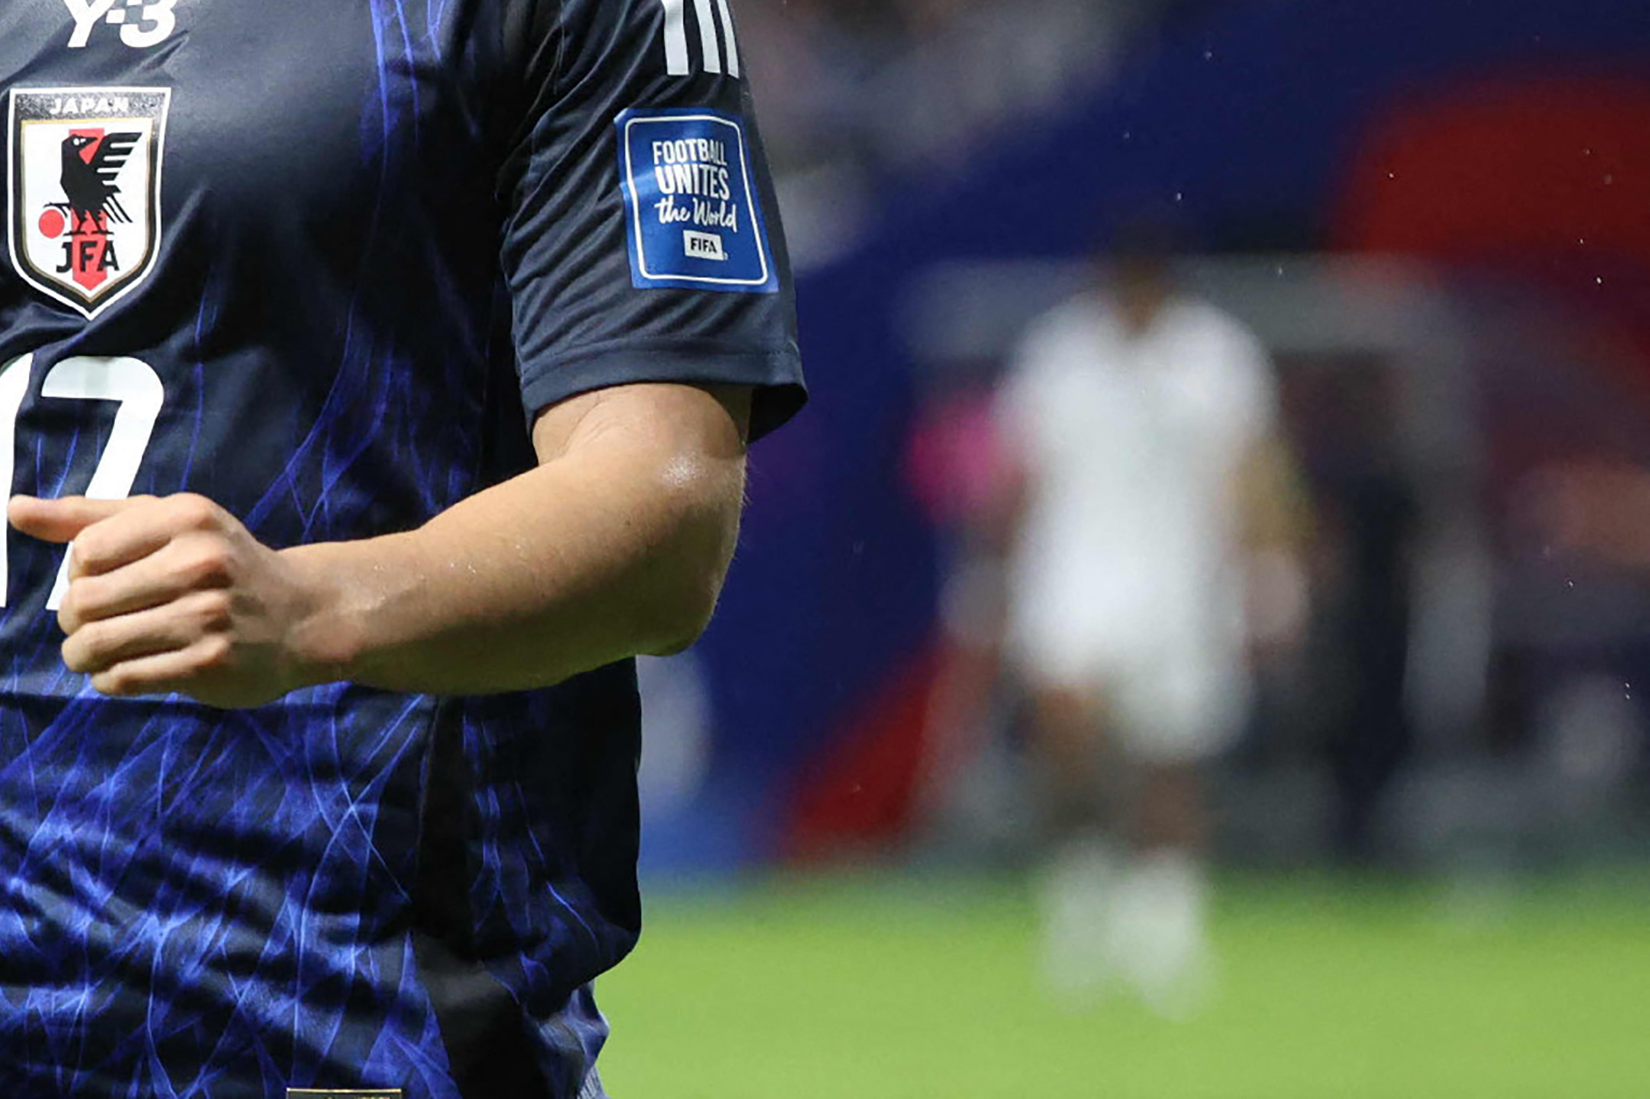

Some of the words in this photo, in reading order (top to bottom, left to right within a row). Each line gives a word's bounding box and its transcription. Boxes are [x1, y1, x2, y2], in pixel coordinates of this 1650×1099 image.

[49, 97, 129, 114] JAPAN
[653, 139, 727, 166] FOOTBALL
[655, 164, 730, 200] UNITES
[654, 195, 691, 224] the
[692, 197, 738, 233] World
[56, 240, 120, 273] JFA
[690, 237, 717, 253] FIFA
